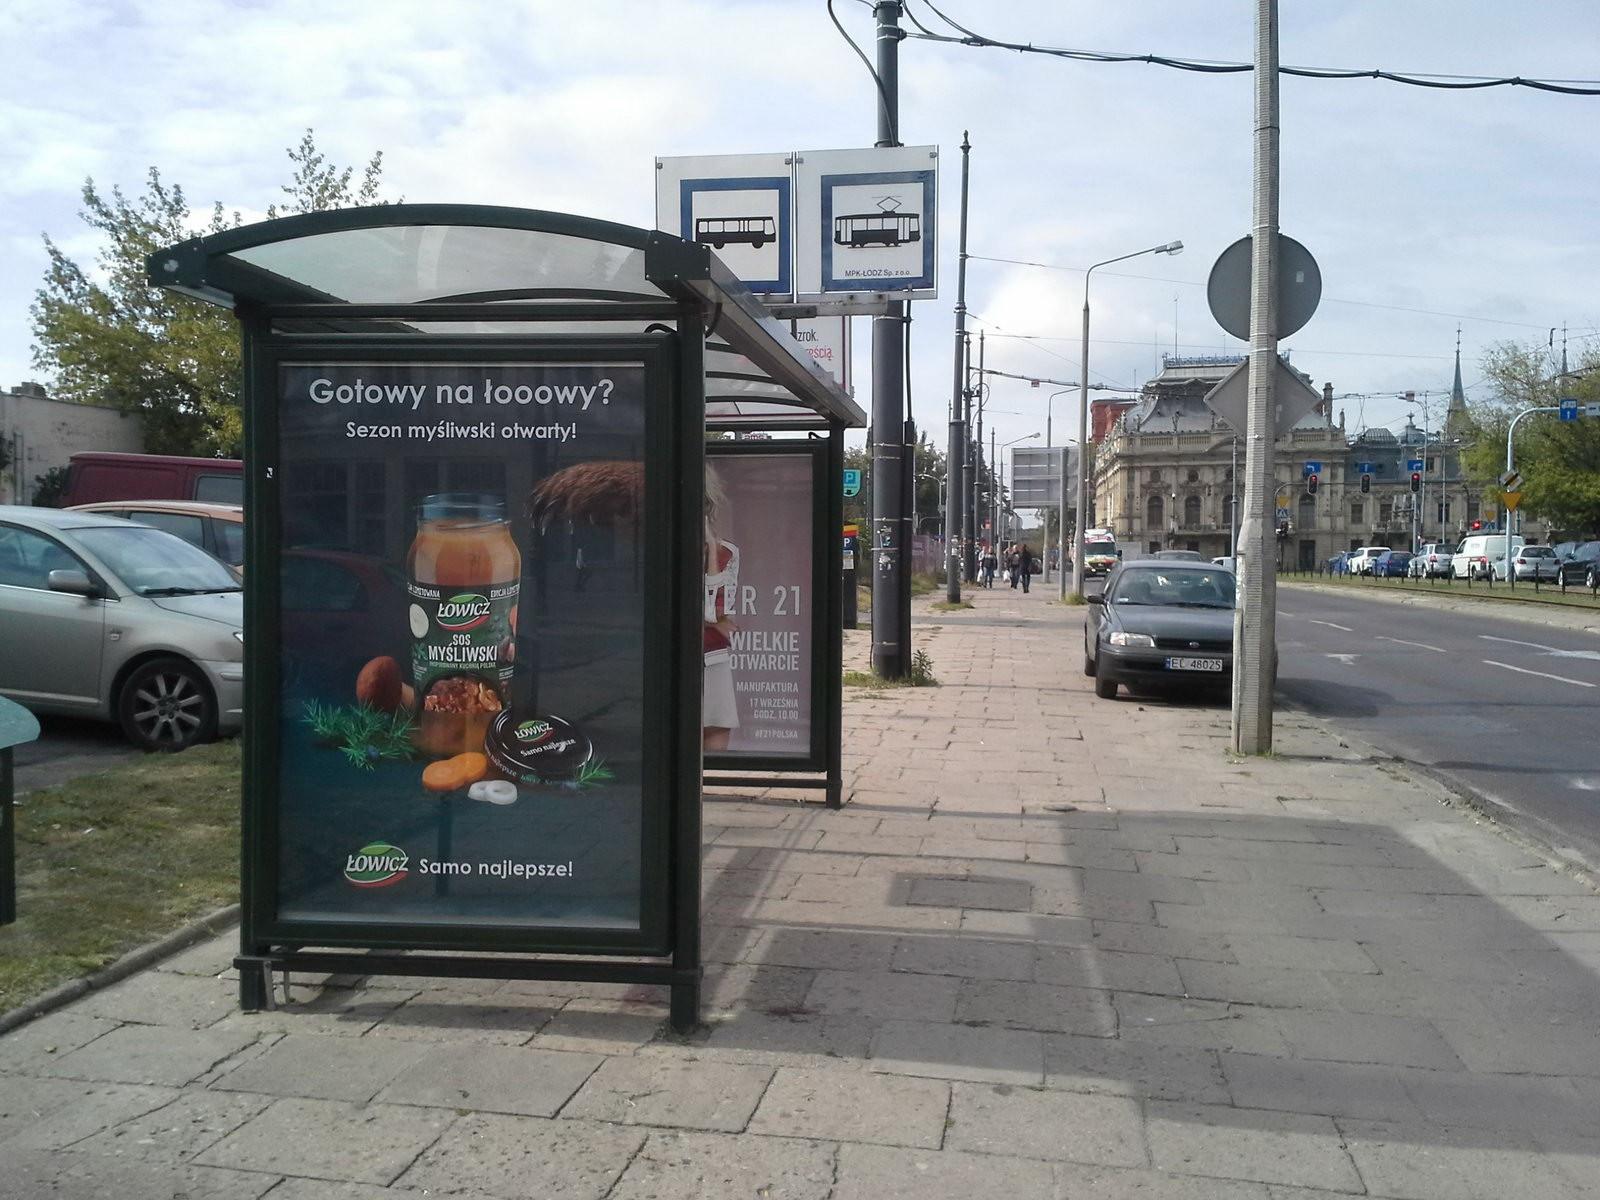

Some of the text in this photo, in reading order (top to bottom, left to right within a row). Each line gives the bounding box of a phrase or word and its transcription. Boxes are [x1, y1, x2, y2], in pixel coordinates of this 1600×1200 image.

[797, 329, 818, 342] zrok.
[309, 379, 615, 411] Gotowy na łooowy?
[346, 421, 577, 443] Sezon myśliwski otwarty!
[773, 585, 801, 616] 21
[437, 601, 491, 618] ŁOWICZ
[452, 634, 471, 646] SOS
[729, 631, 799, 652] WIELKIE
[428, 643, 498, 662] MYŚLIWSKI
[729, 654, 799, 671] OTWARCIE
[1190, 660, 1221, 670] 48025
[736, 681, 799, 693] MANUFAKTURA
[760, 697, 799, 708] WRZEŚNIA
[514, 723, 553, 739] ŁOWICZ
[520, 747, 543, 757] Samo
[346, 855, 409, 872] ŁOWICZ
[419, 859, 574, 879] Samo najlepsze!
